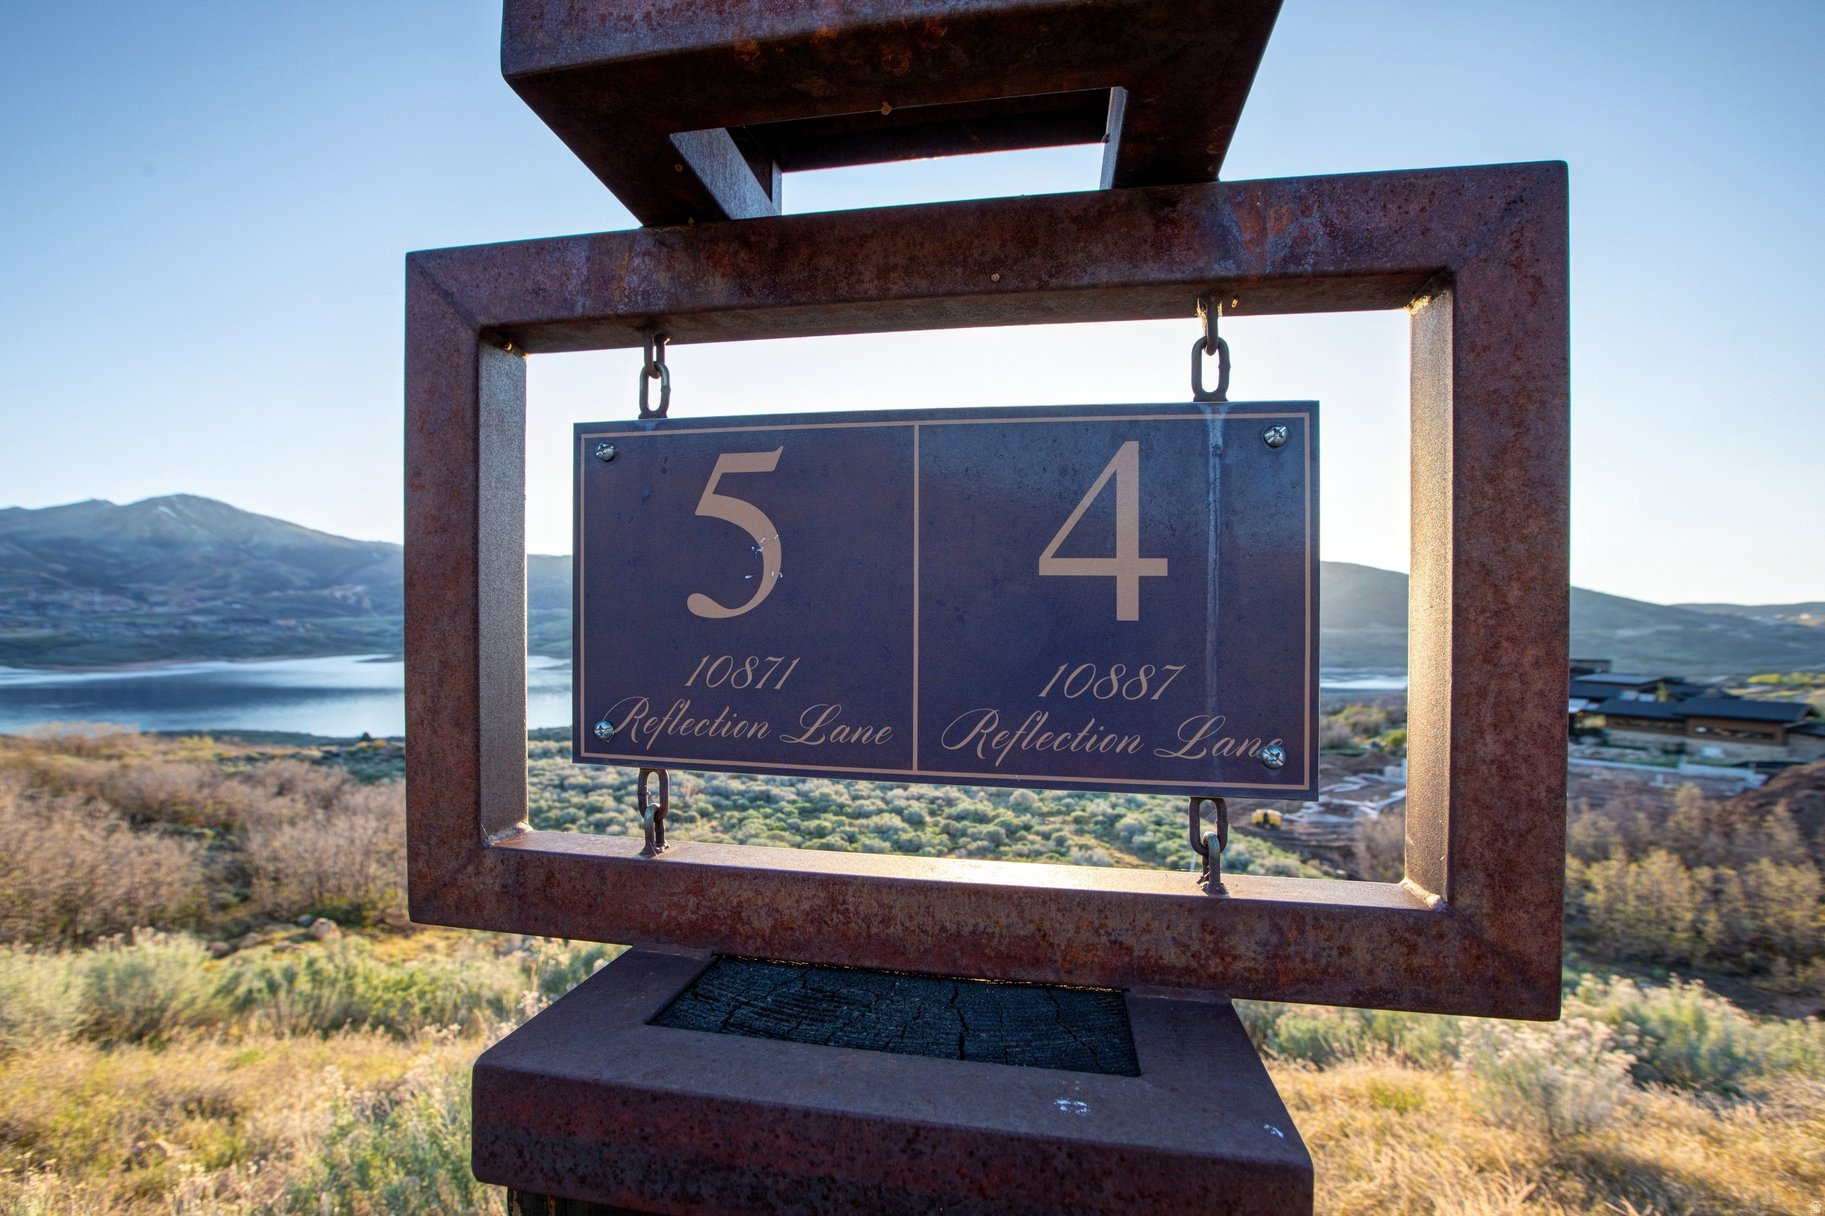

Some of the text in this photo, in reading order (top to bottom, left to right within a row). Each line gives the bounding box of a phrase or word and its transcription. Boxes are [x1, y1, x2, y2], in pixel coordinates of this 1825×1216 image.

[686, 445, 784, 619] 5
[1038, 440, 1168, 621] 4
[684, 654, 801, 690] 10871
[1037, 662, 1187, 701] 10887
[600, 695, 896, 751] Reflection Lane
[941, 707, 1145, 768] Reflection
